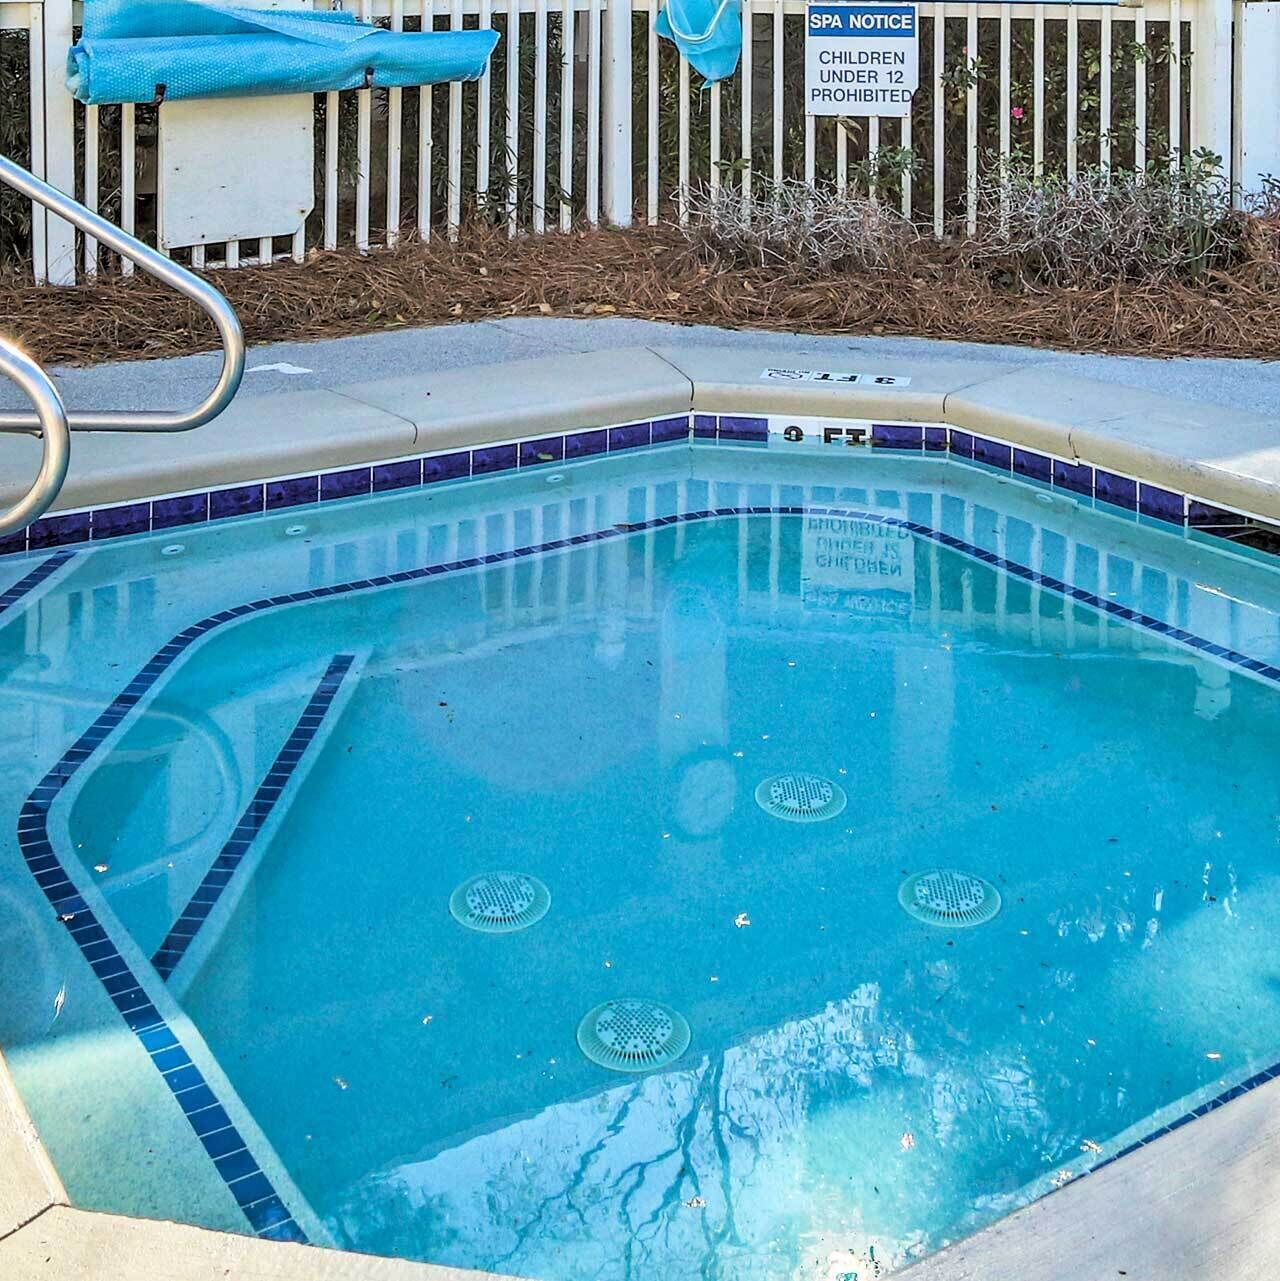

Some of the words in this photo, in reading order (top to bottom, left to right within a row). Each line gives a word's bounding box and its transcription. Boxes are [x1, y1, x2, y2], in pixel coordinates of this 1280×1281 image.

[810, 14, 843, 29] SPA
[849, 14, 912, 29] NOTICE
[819, 51, 905, 65] CHILDREN
[820, 70, 878, 83] UNDER
[886, 70, 904, 84] 12
[811, 88, 912, 103] PROHIBITED
[874, 377, 896, 385] 3
